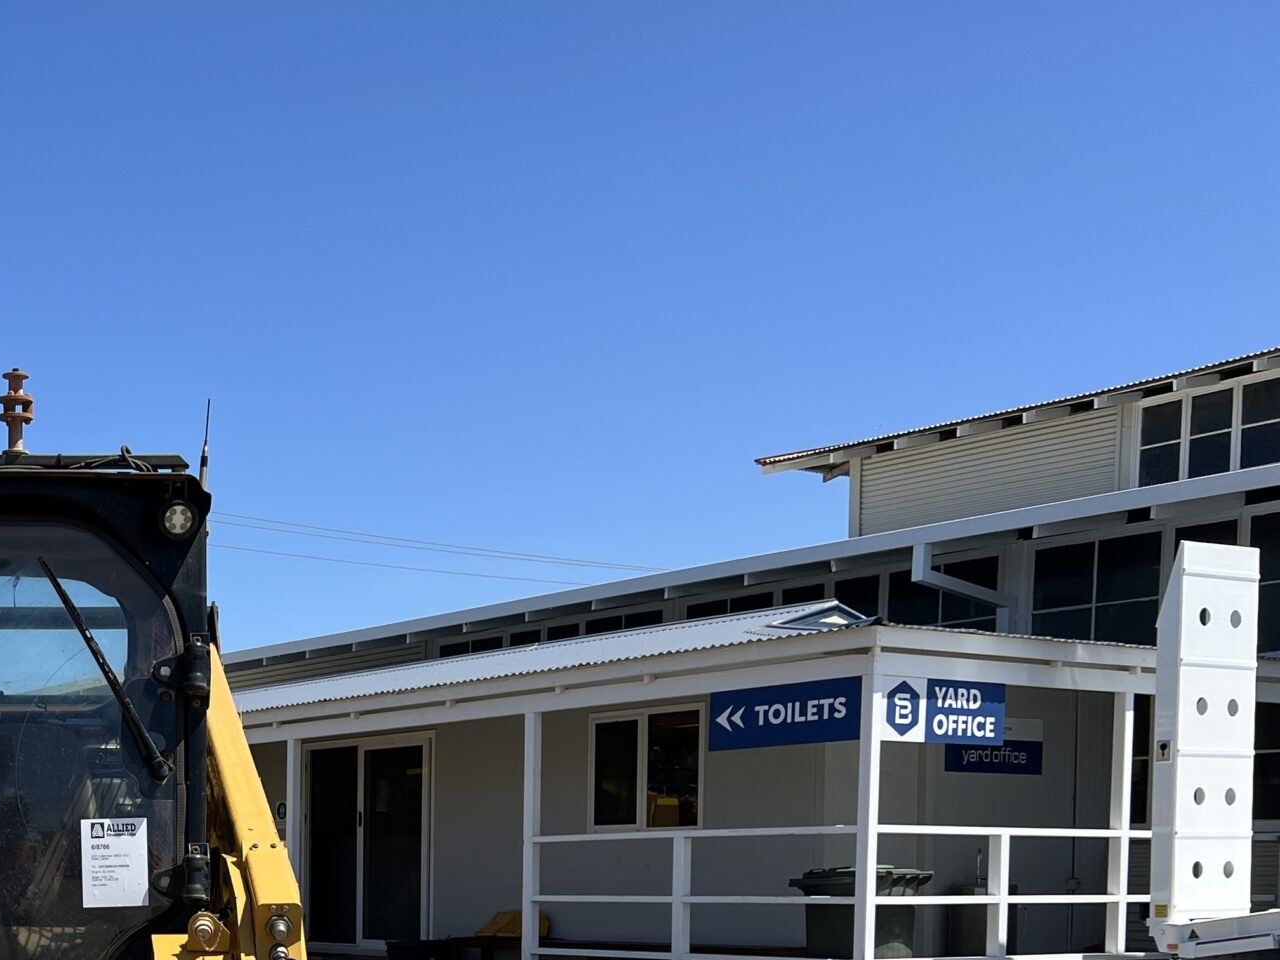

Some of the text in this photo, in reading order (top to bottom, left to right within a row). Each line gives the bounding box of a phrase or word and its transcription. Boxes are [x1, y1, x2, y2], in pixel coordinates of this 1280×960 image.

[934, 686, 982, 710] YARD
[754, 696, 848, 727] TOILETS
[932, 713, 996, 738] OFFICE
[962, 747, 1027, 765] yard office
[106, 824, 136, 832] ALLIED
